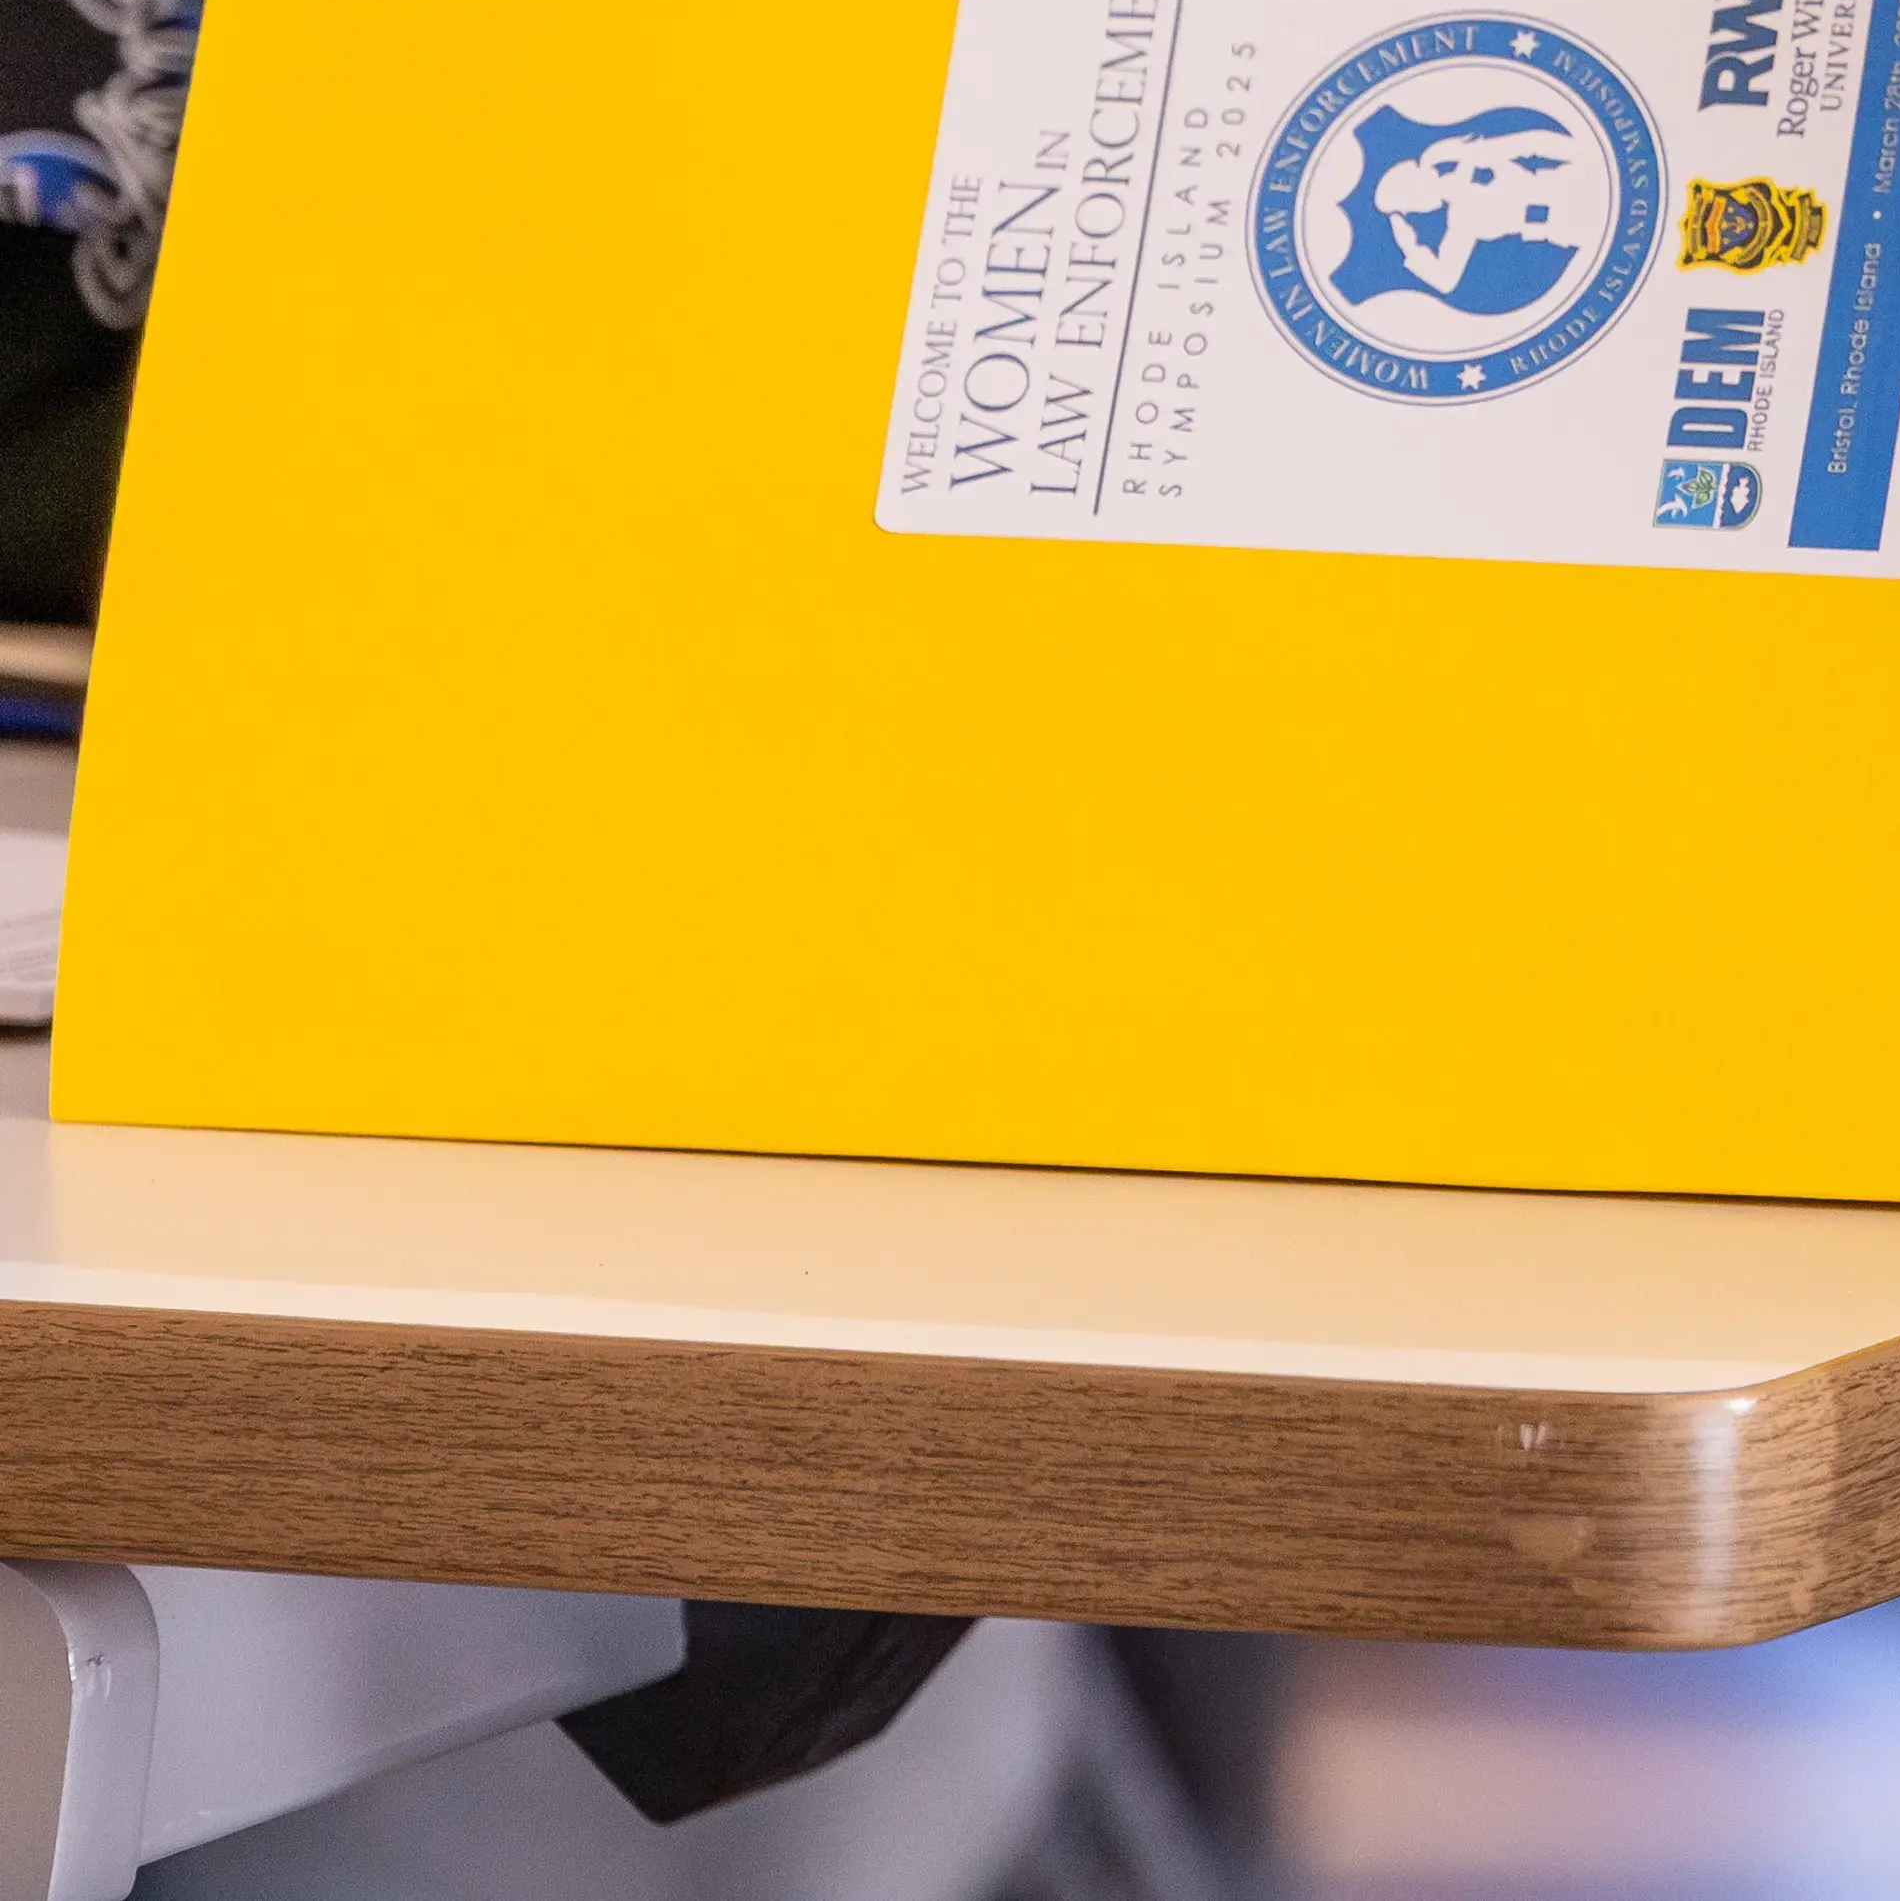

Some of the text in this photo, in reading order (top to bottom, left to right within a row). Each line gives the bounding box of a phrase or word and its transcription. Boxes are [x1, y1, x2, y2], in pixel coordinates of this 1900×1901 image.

[1263, 25, 1480, 391] WOMEN IN LAW ENFORCEMENT
[1776, 47, 1821, 140] Roger
[949, 128, 1072, 492] WOMEN IN
[1122, 106, 1209, 496] RHODE ISLAND
[1158, 40, 1257, 497] SYMPOSIUM 2025
[1508, 48, 1650, 378] RHODE ISLAND SYMPOSIUM
[1853, 242, 1883, 311] Island
[900, 174, 983, 496] WELCOME TO THE
[1029, 374, 1095, 497] LAW
[1666, 307, 1767, 451] DEM
[1746, 308, 1786, 452] RHODE ISLAND
[1839, 319, 1870, 397] Rhode
